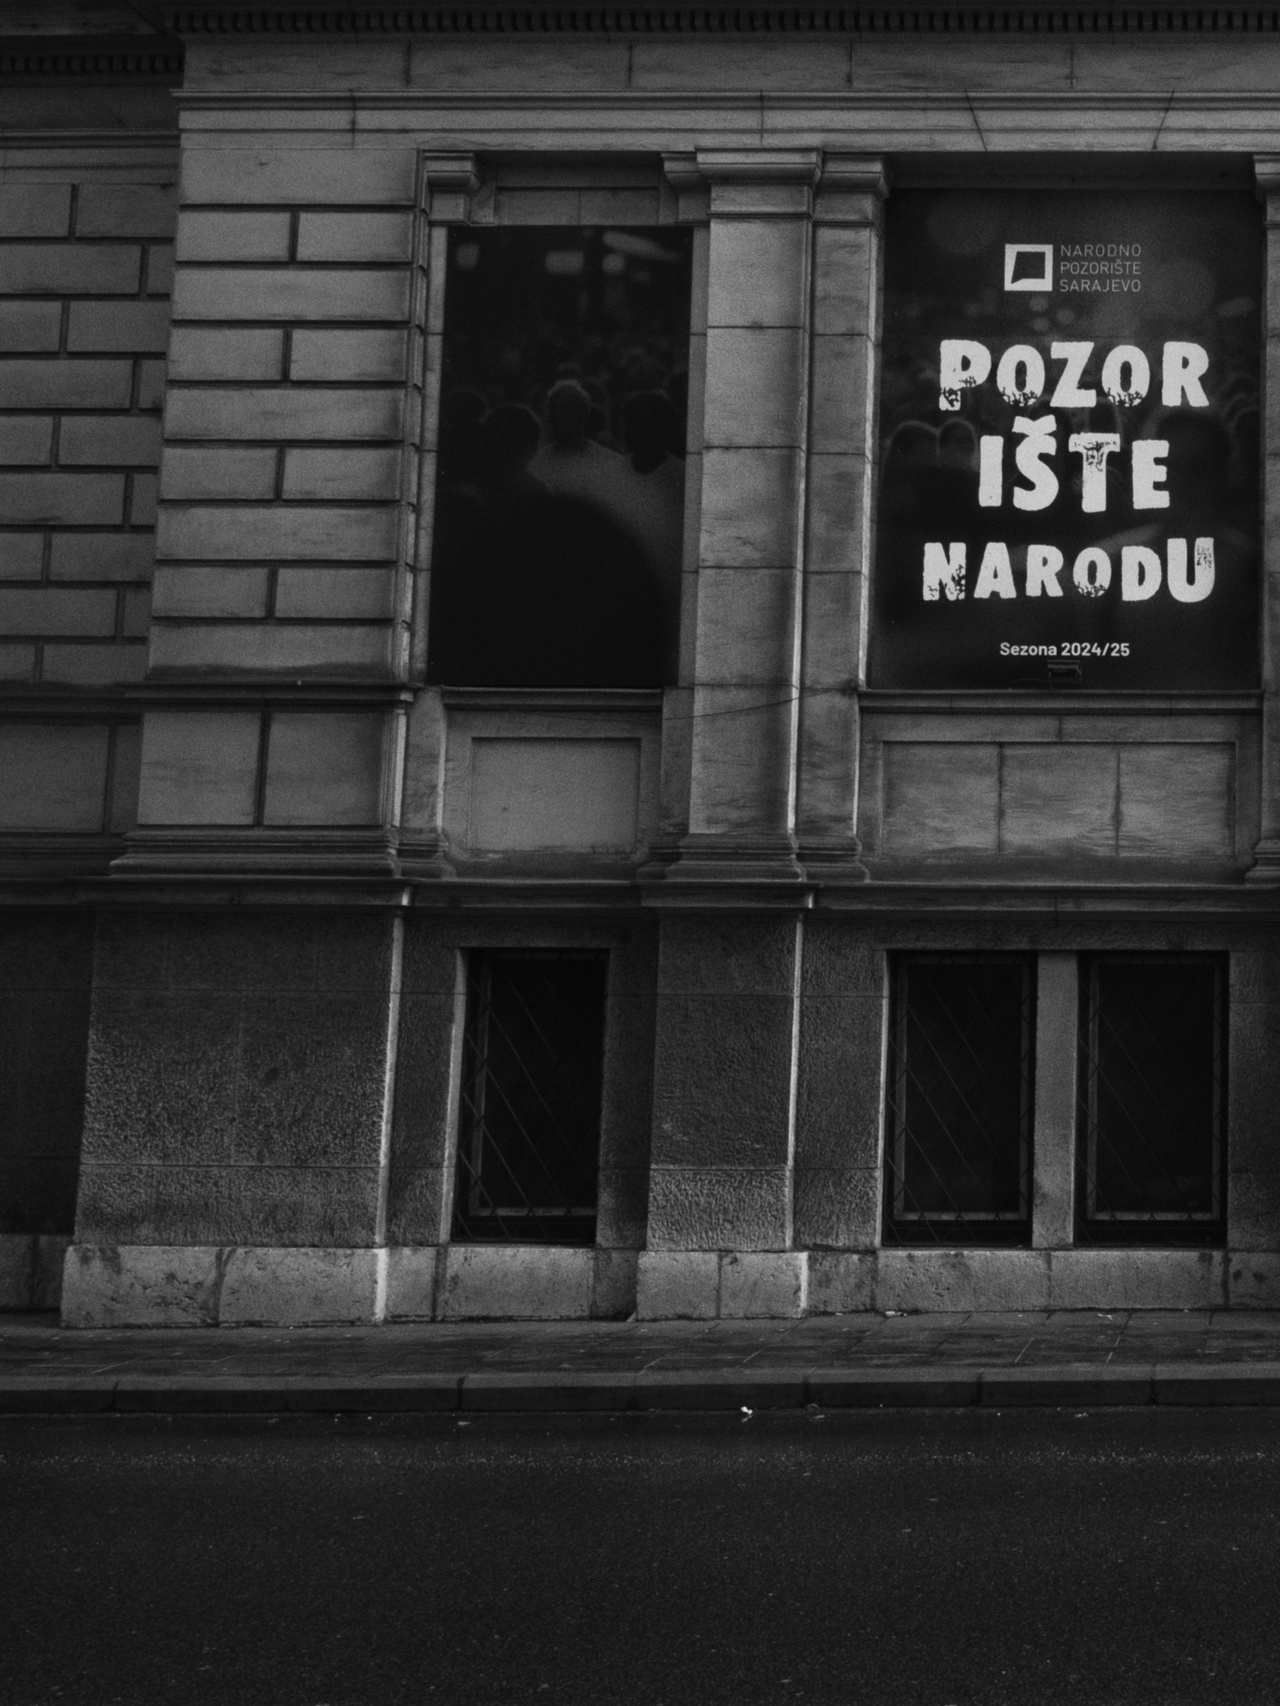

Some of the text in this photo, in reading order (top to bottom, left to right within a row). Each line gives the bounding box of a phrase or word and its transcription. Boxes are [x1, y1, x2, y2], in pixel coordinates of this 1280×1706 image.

[1060, 244, 1142, 257] NARODNO
[1060, 259, 1141, 275] POZORIŠTE
[1060, 279, 1141, 292] SARAJEVO
[939, 340, 1209, 411] POZOR
[979, 415, 1170, 512] IŠTE
[923, 537, 1215, 602] NARODU
[1000, 642, 1130, 657] Sezona 2024/25
